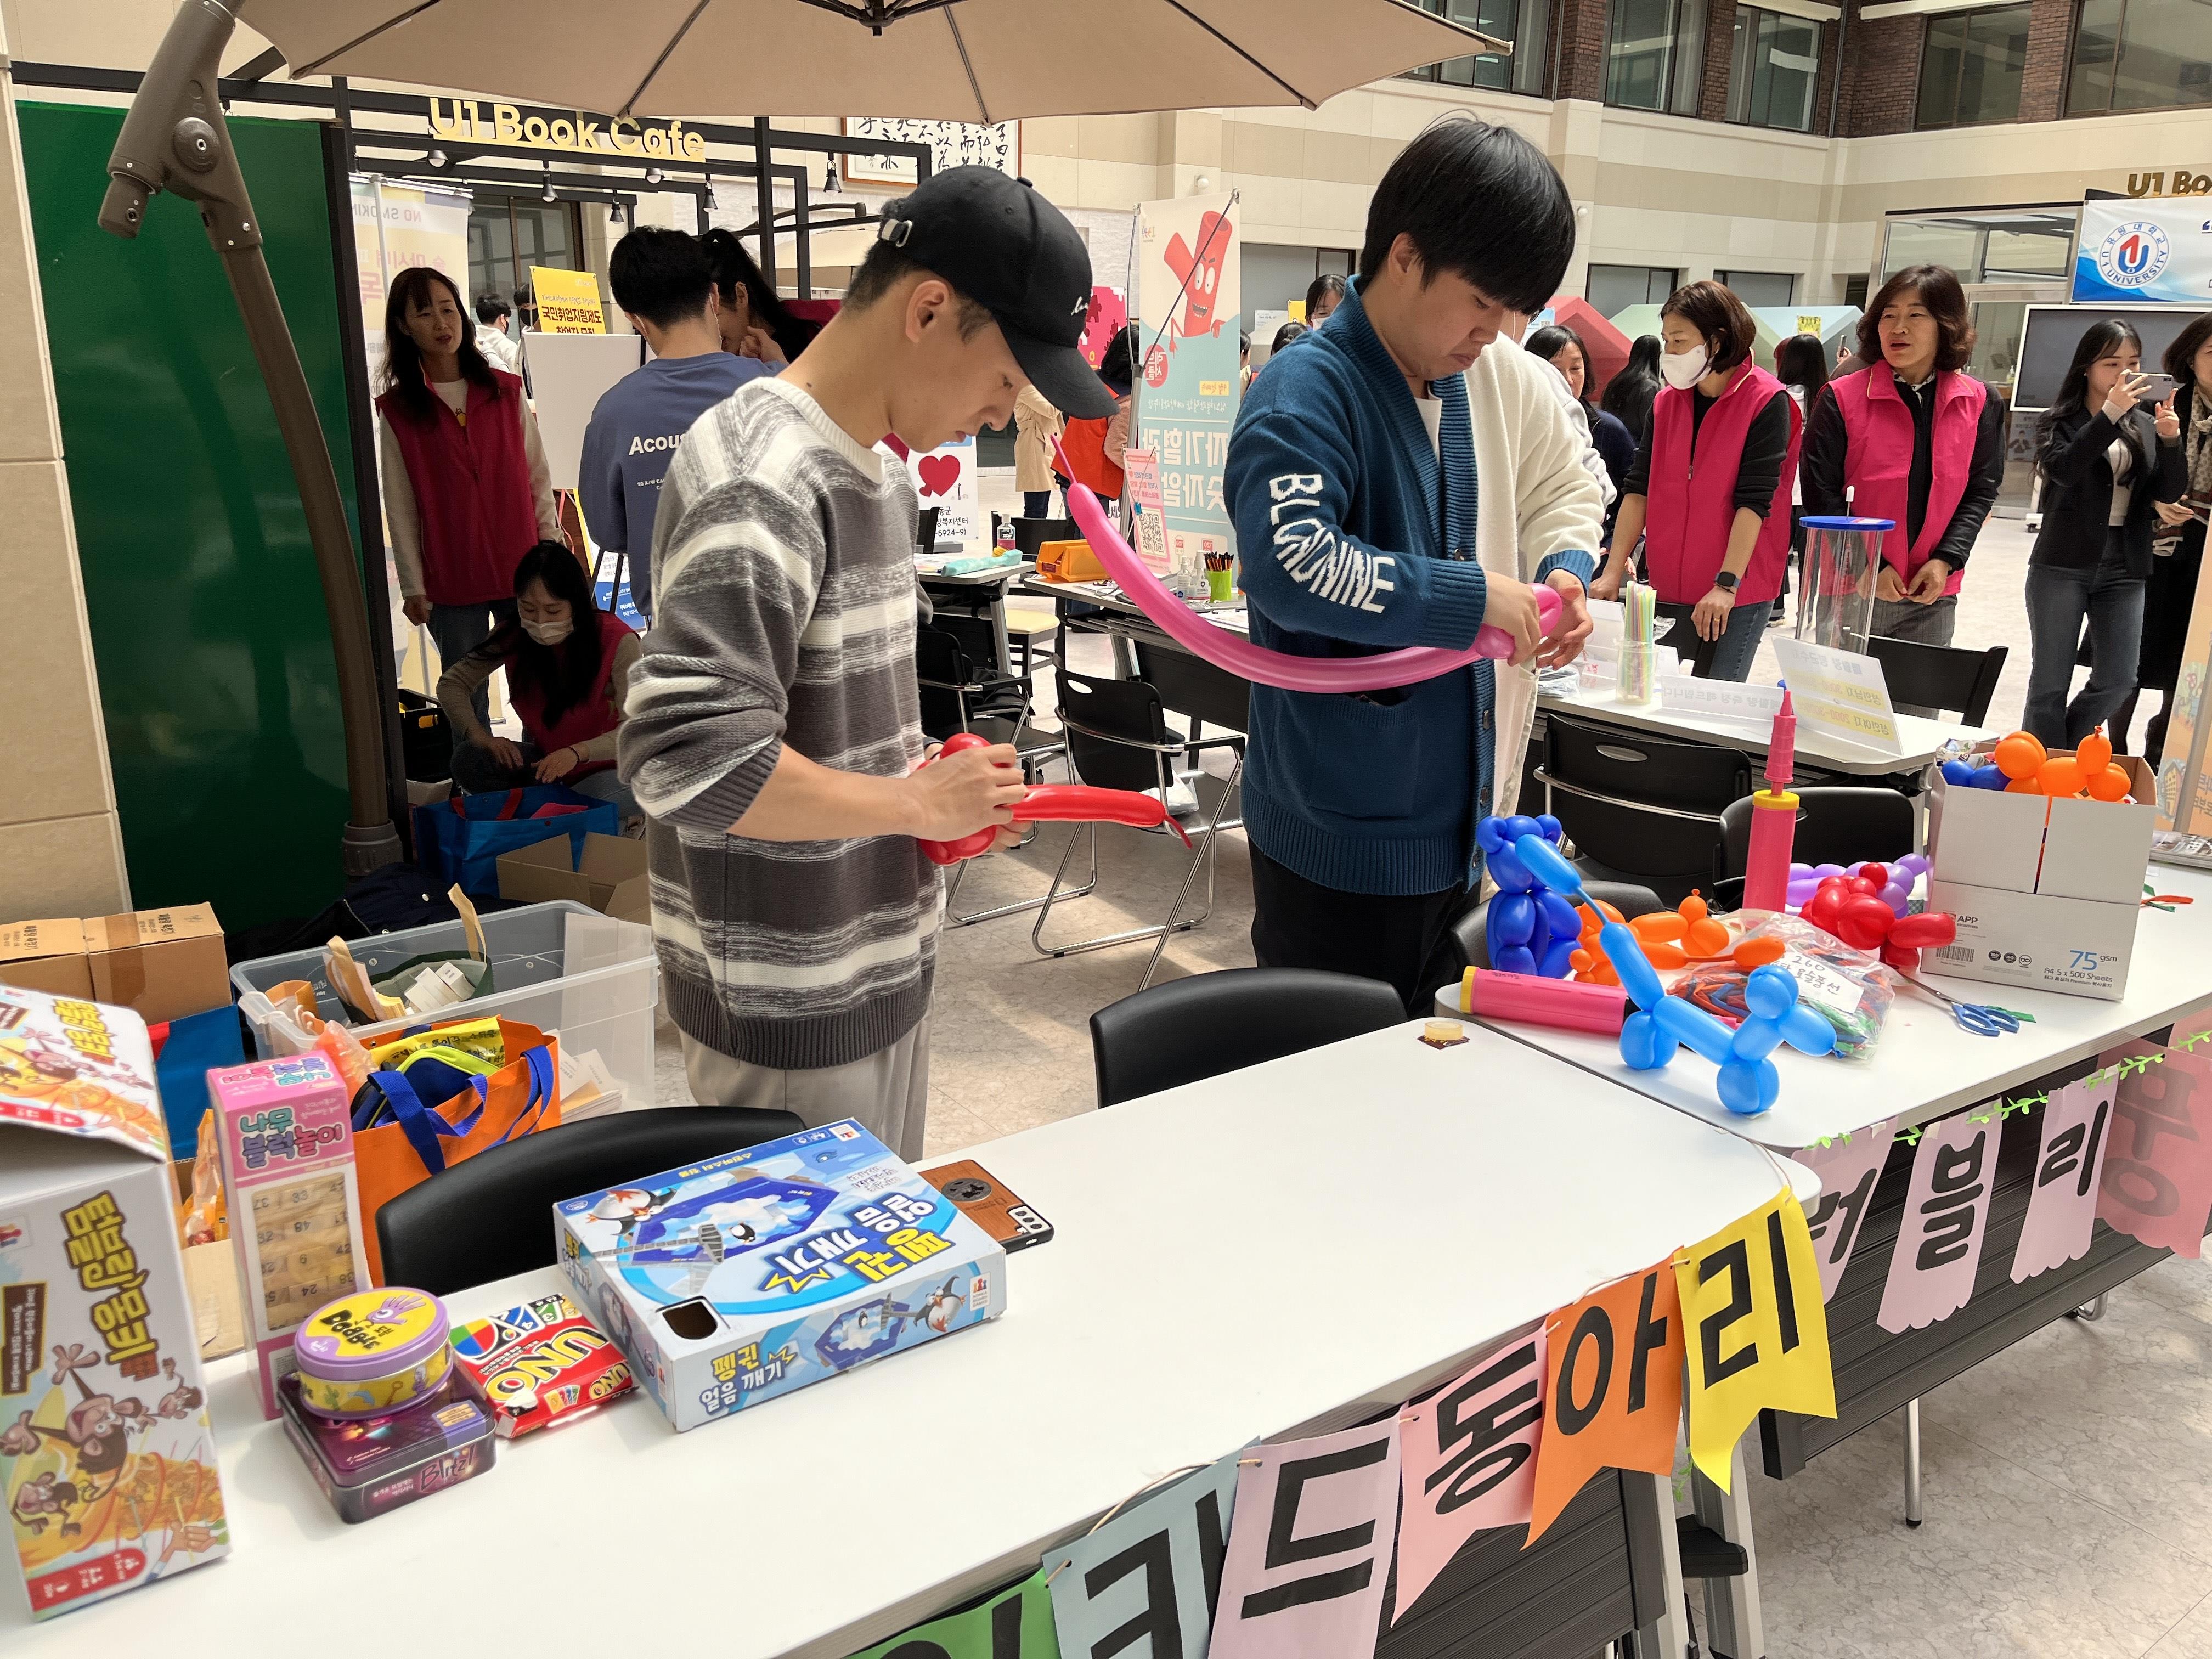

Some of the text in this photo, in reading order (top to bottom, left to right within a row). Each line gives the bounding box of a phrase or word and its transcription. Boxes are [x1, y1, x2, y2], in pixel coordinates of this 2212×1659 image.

[429, 97, 706, 159] U1 Book Cafe
[2127, 172, 2165, 198] U1
[2107, 223, 2166, 245] 유원대학교
[2107, 250, 2168, 284] UNIVERSITY
[541, 306, 602, 324] 국민취업지원제도
[1957, 915, 1978, 924] APP
[2070, 950, 2097, 971] 75
[2086, 973, 2113, 983] Sheets
[239, 1108, 294, 1133] 나무
[242, 1124, 345, 1169] 블럭놀이
[854, 1194, 934, 1233] 얼음
[774, 1228, 868, 1275] 깨기
[843, 1227, 956, 1283] 펭귄
[485, 1327, 610, 1403] UNO
[589, 1362, 631, 1399] UNO
[712, 1342, 760, 1382] 펭귄
[700, 1361, 783, 1412] 얼음 깨기
